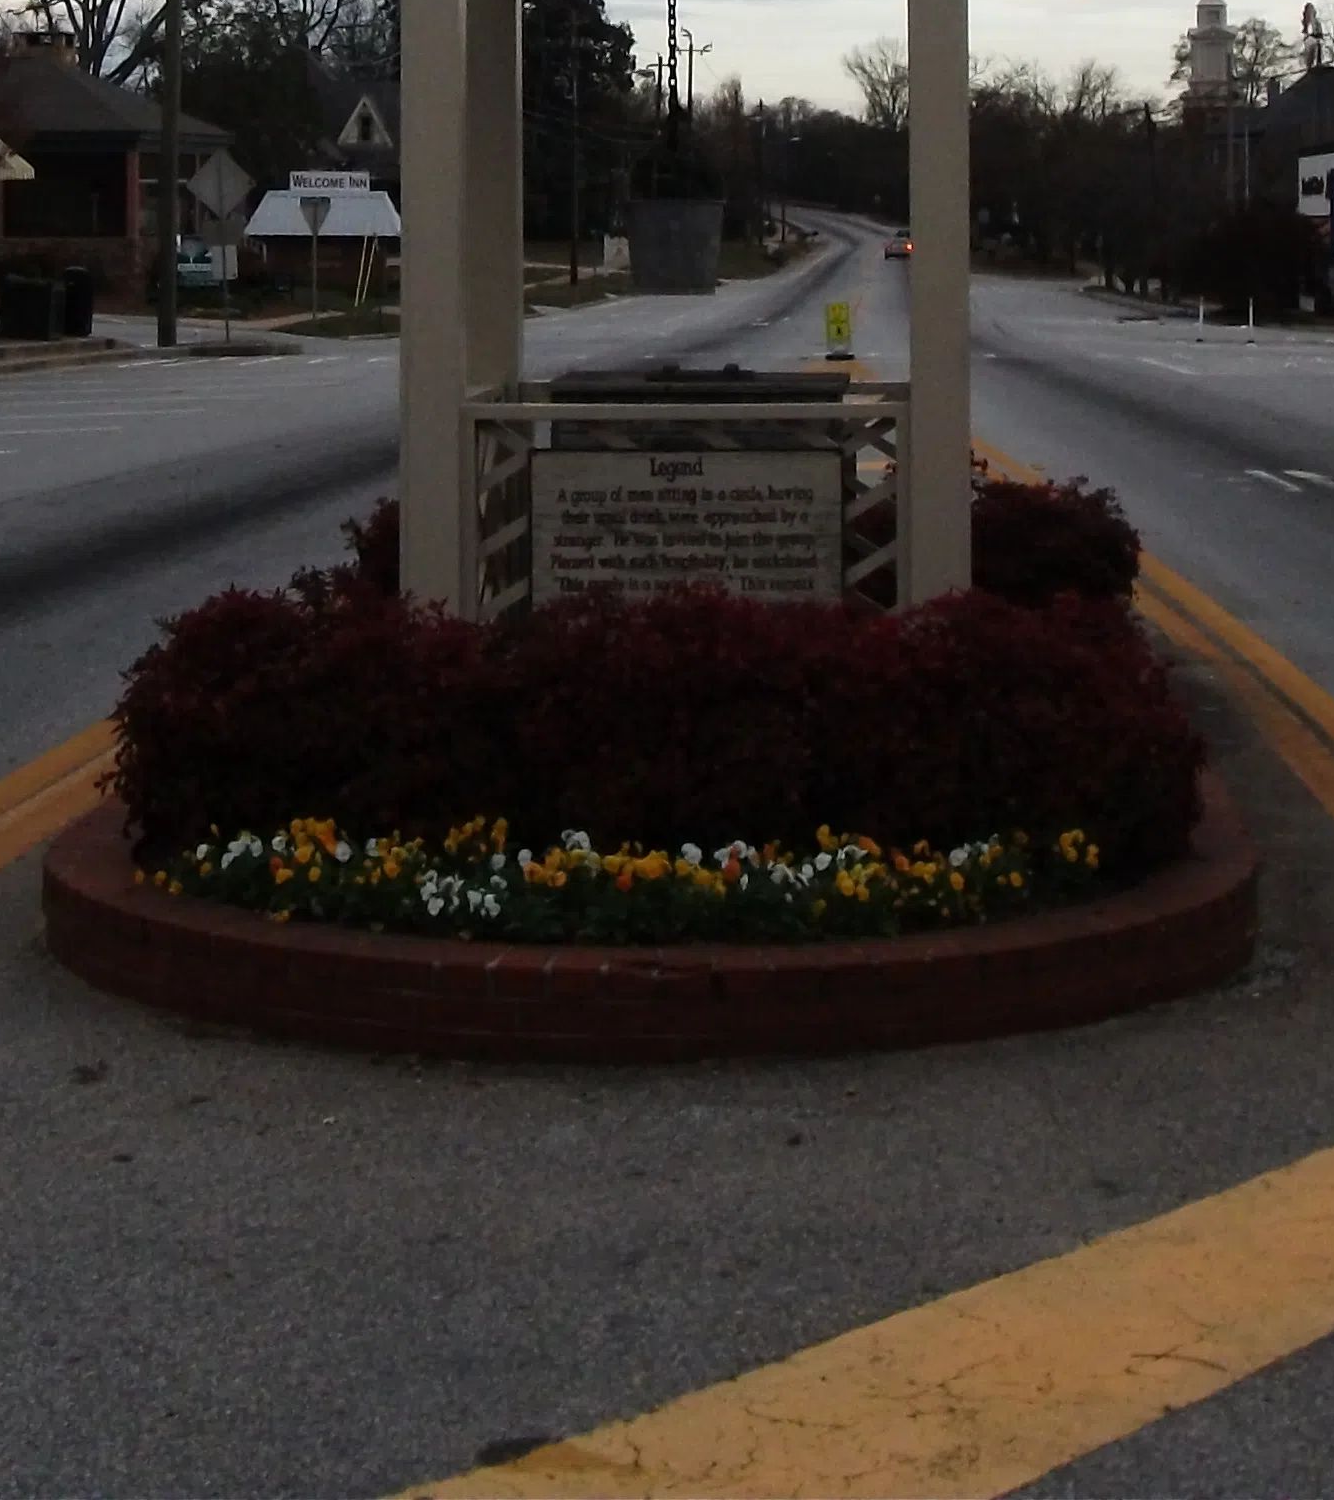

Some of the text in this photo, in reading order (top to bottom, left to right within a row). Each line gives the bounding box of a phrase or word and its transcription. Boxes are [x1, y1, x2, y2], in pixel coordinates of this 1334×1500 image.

[291, 174, 368, 189] WELCOME INN
[649, 456, 703, 482] Legend
[557, 488, 567, 502] A
[571, 490, 607, 507] group
[767, 485, 813, 505] having
